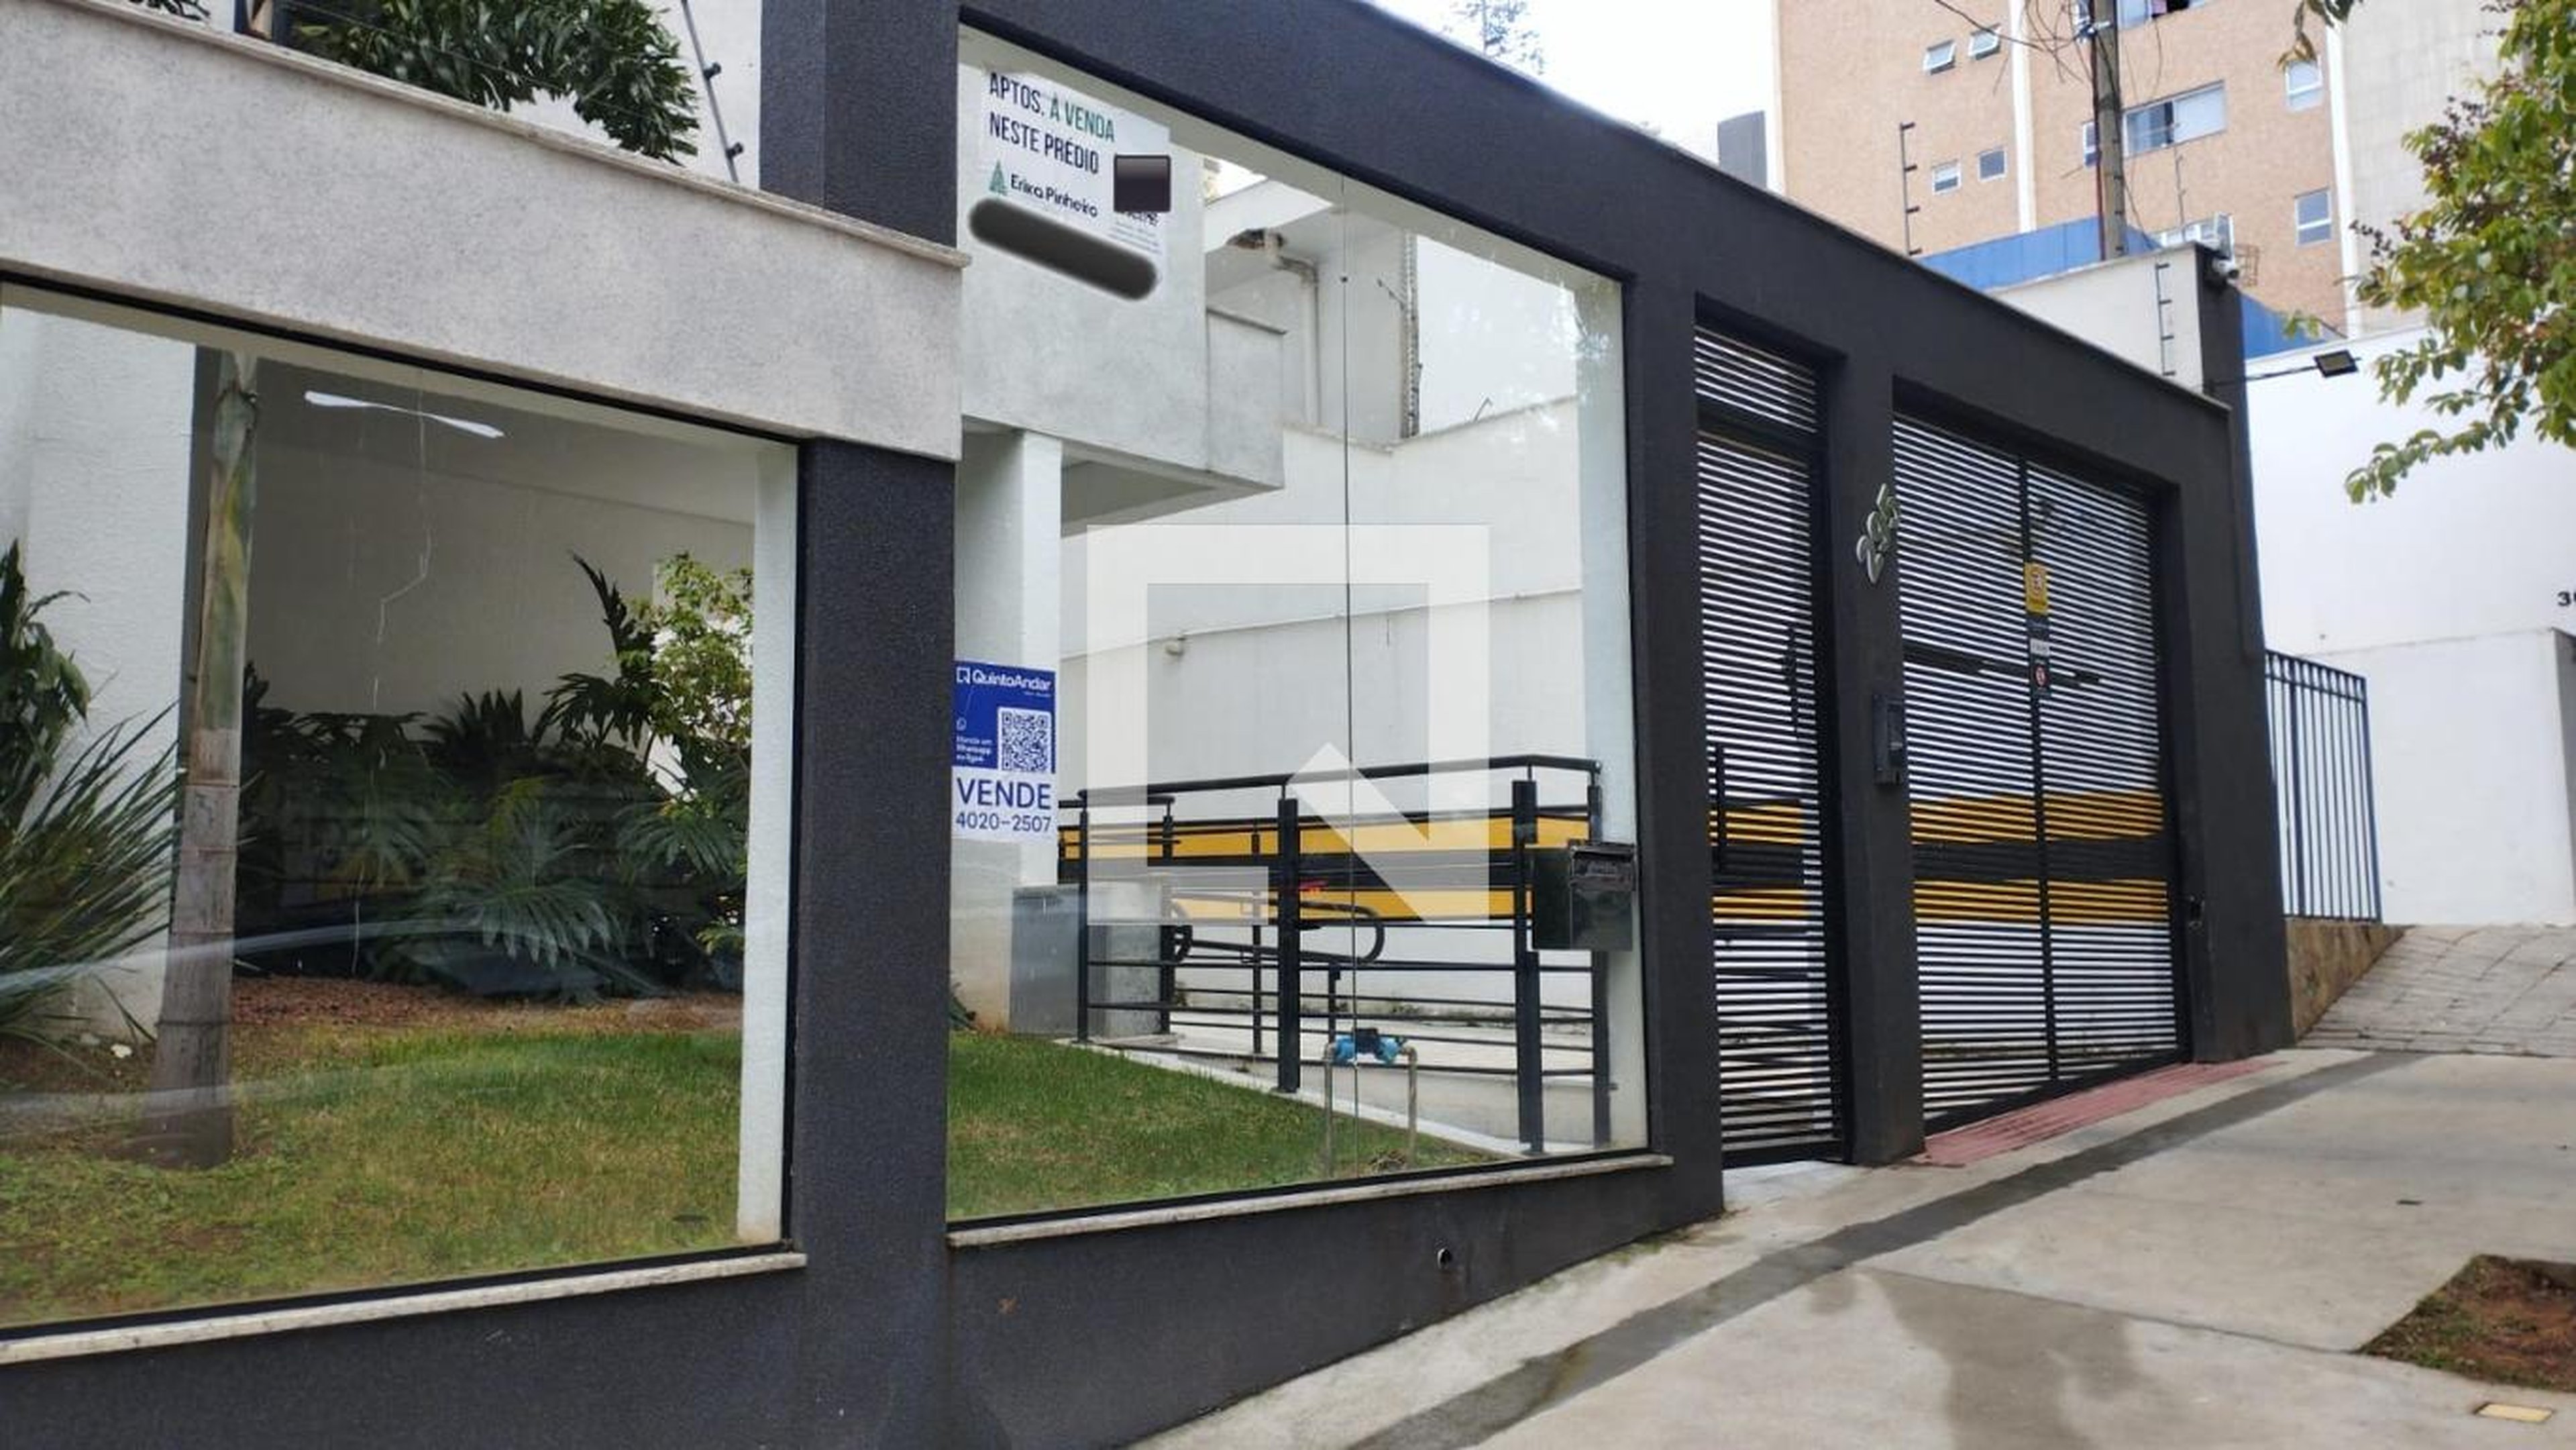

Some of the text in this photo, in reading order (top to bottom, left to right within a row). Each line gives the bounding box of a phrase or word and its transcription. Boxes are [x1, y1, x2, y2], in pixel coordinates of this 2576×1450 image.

[989, 72, 1044, 116] APTOS.
[1065, 101, 1115, 142] VENDA
[989, 111, 1099, 174] NESTE PRÉDIO
[2557, 591, 2576, 607] 3
[972, 669, 1051, 691] QuintoAndar
[957, 777, 1051, 810] VENDE
[955, 811, 1052, 832] 4020-2507
